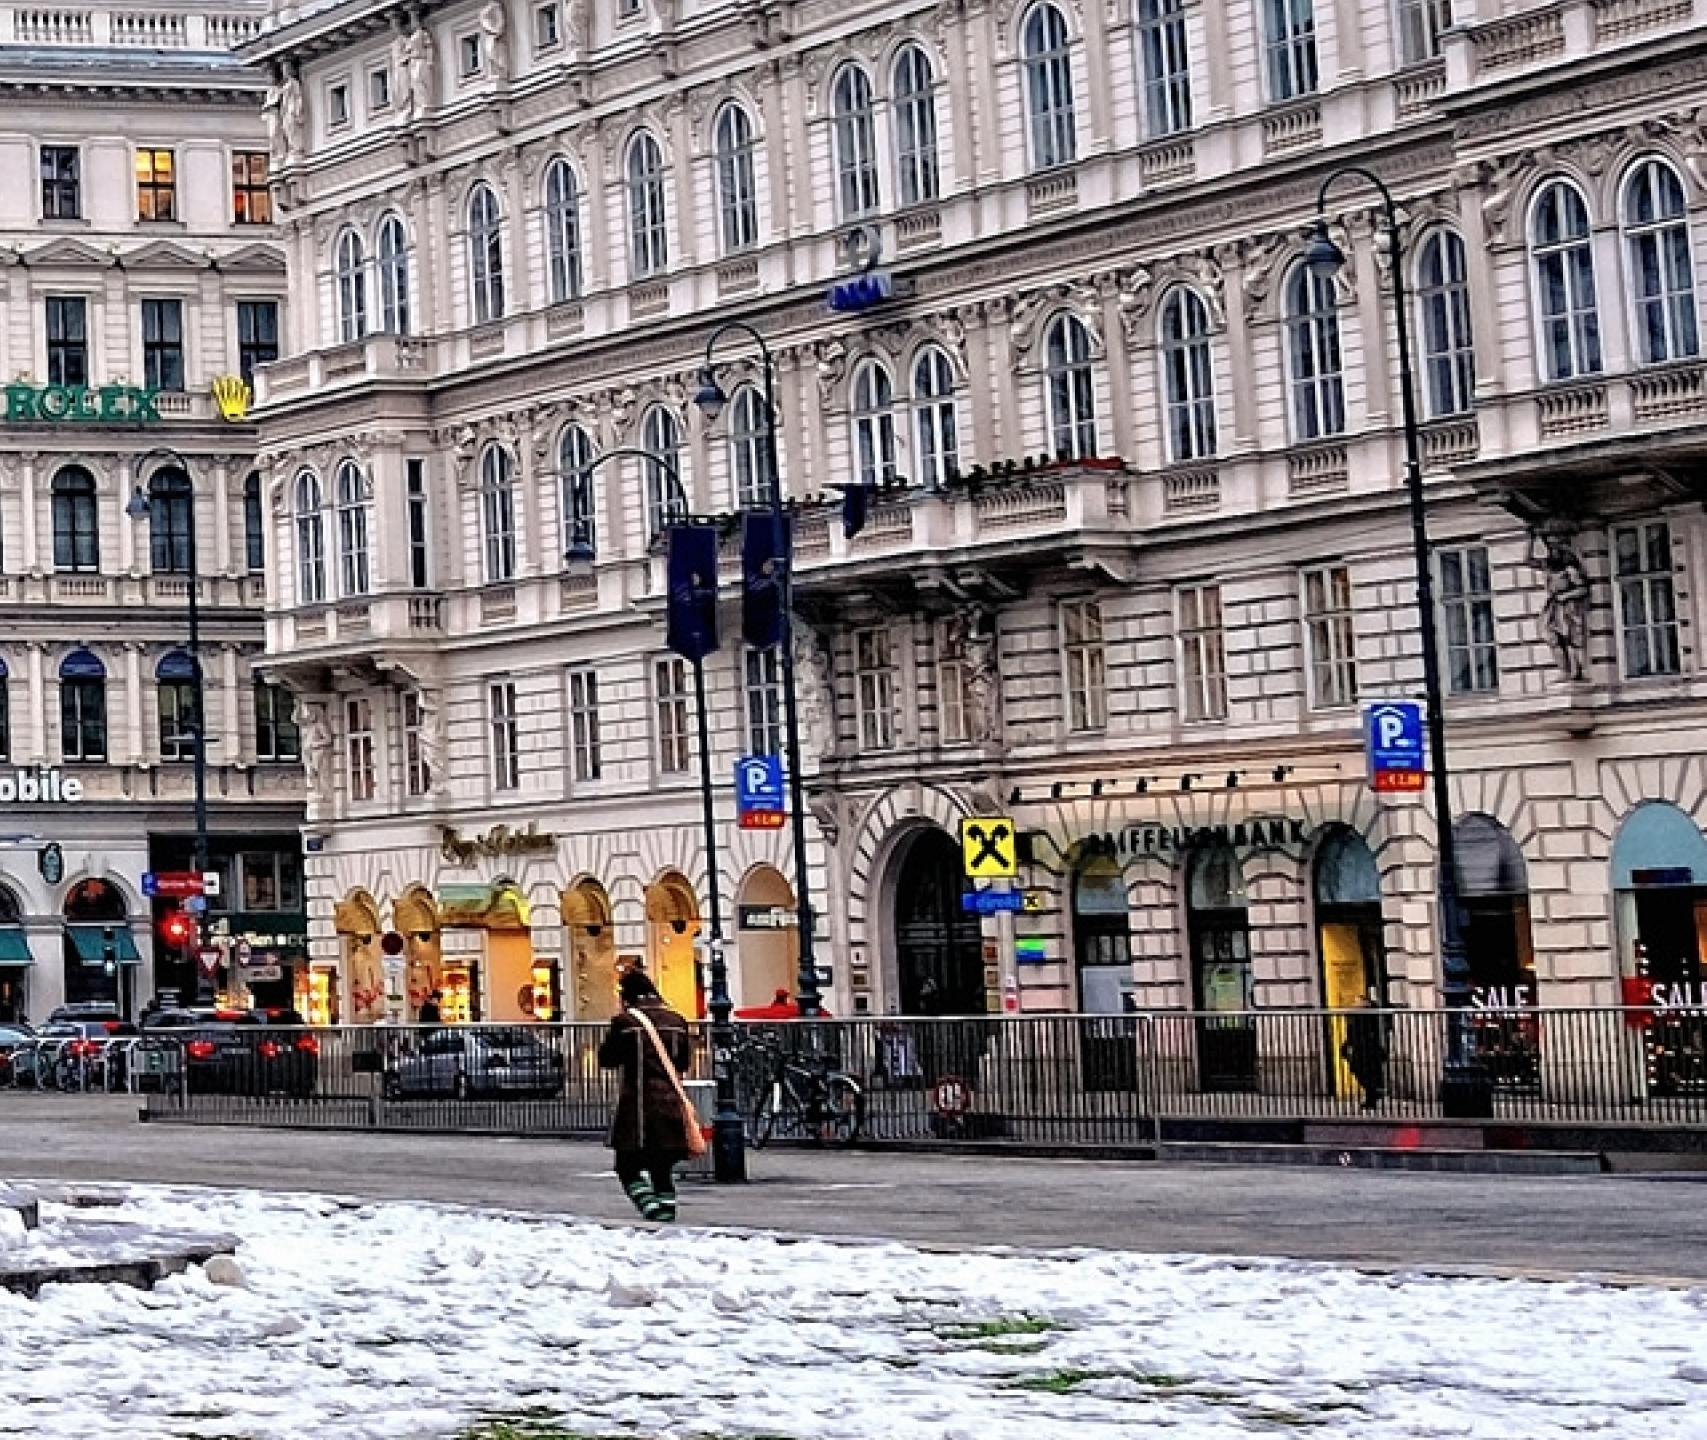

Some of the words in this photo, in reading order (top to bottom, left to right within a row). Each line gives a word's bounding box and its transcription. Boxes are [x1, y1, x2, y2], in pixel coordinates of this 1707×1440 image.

[4, 383, 161, 422] ROLEX
[1380, 716, 1403, 748] P
[748, 767, 766, 794] P
[1471, 985, 1531, 1018] SALE
